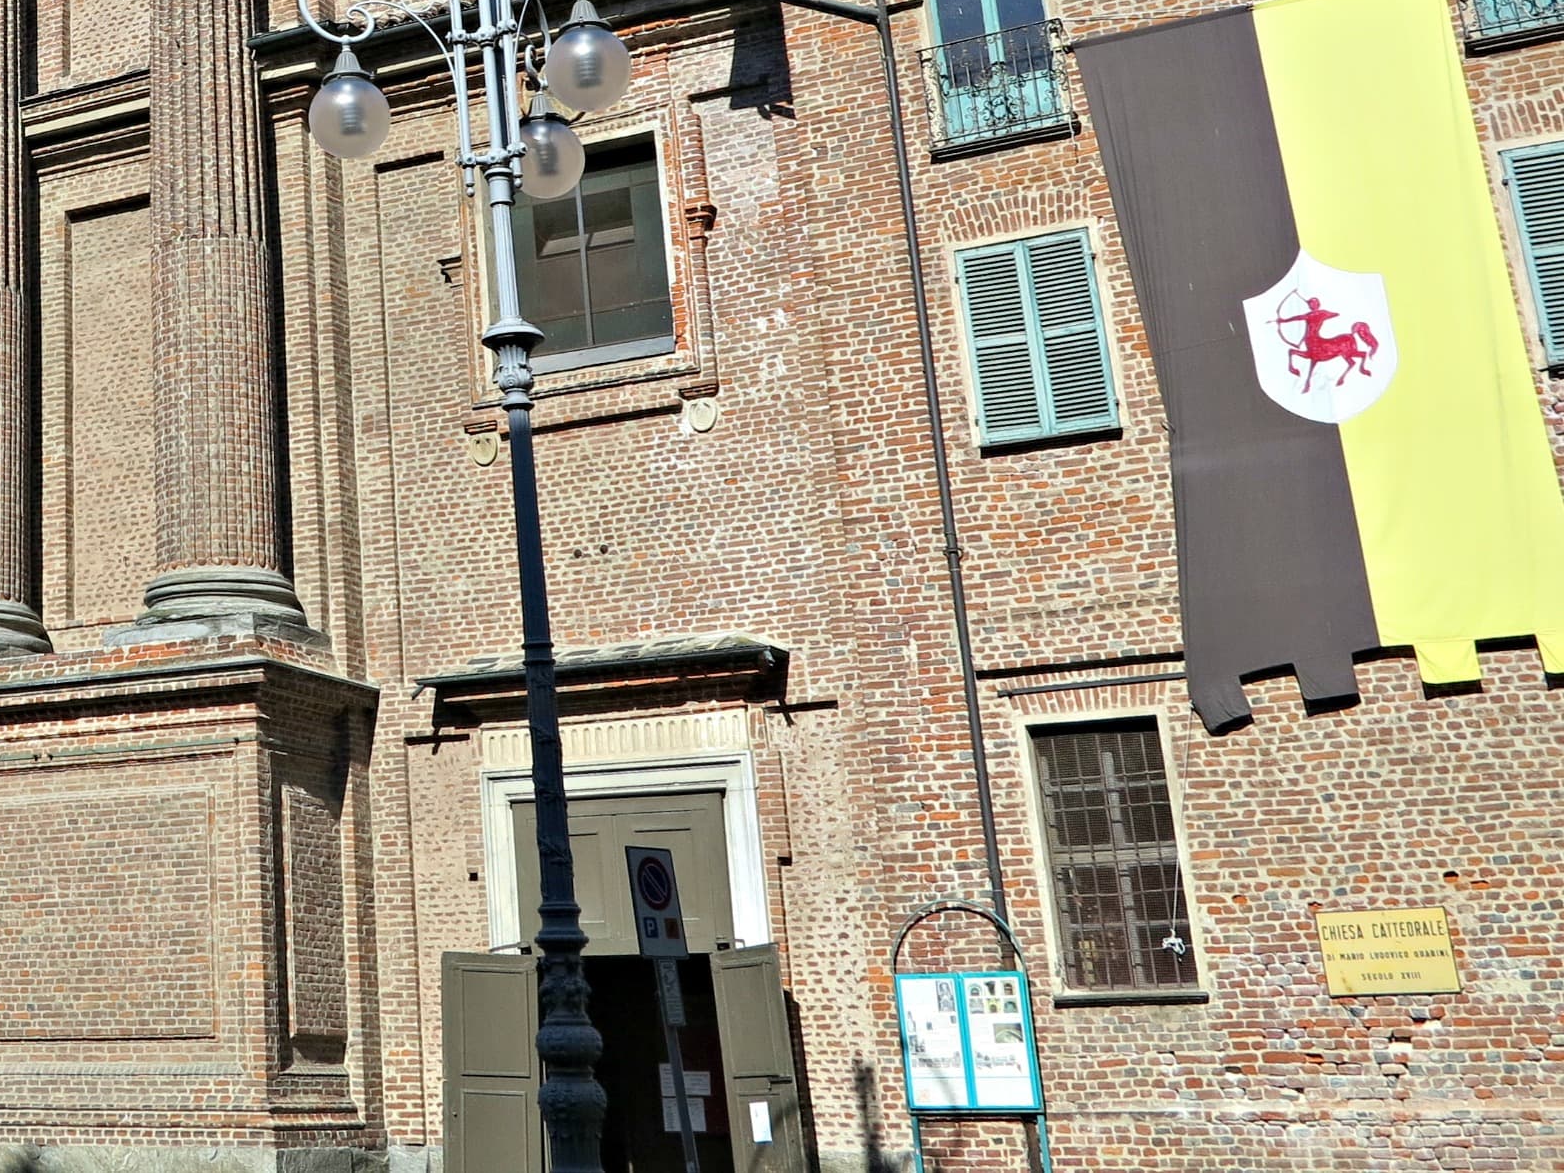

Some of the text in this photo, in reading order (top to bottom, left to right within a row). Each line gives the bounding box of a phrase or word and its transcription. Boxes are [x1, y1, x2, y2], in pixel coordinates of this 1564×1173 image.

[1321, 920, 1445, 941] CHIESA CATTEDRALE
[1326, 953, 1336, 962] DI
[1340, 952, 1365, 961] MARIO
[1369, 950, 1409, 960] LUDOVICO
[1361, 971, 1422, 981] SECOLO XVIII
